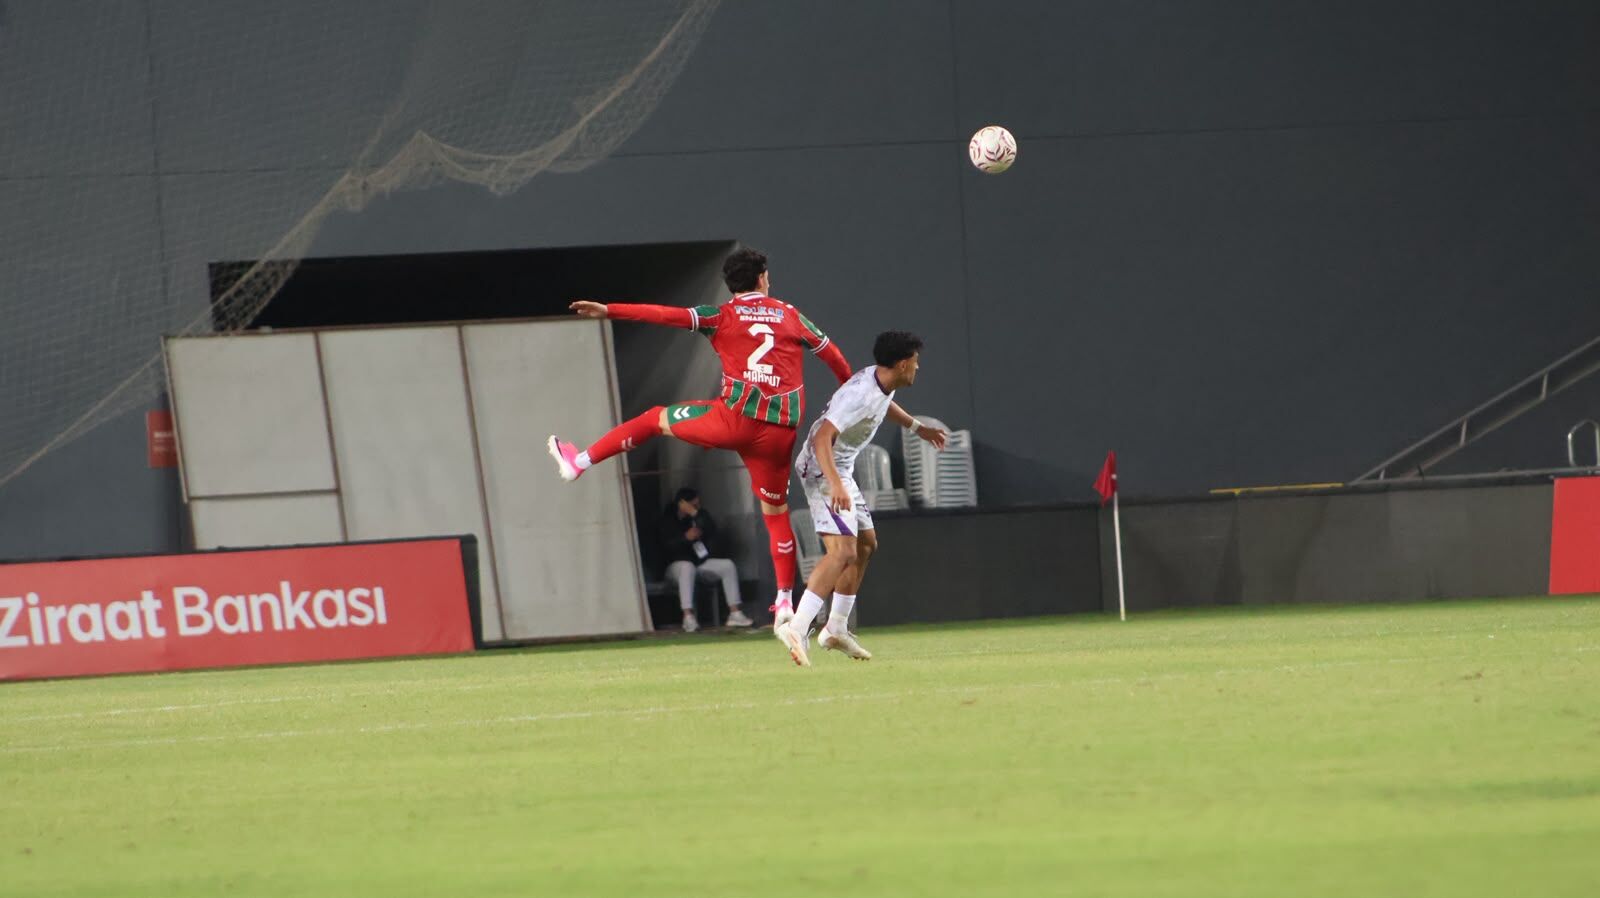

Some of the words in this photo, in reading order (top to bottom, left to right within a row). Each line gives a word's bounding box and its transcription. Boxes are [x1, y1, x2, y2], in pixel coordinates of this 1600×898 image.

[747, 323, 775, 375] 2
[743, 370, 781, 388] MAHMUT
[0, 590, 165, 648] Ziraat
[173, 581, 388, 637] Bankası
